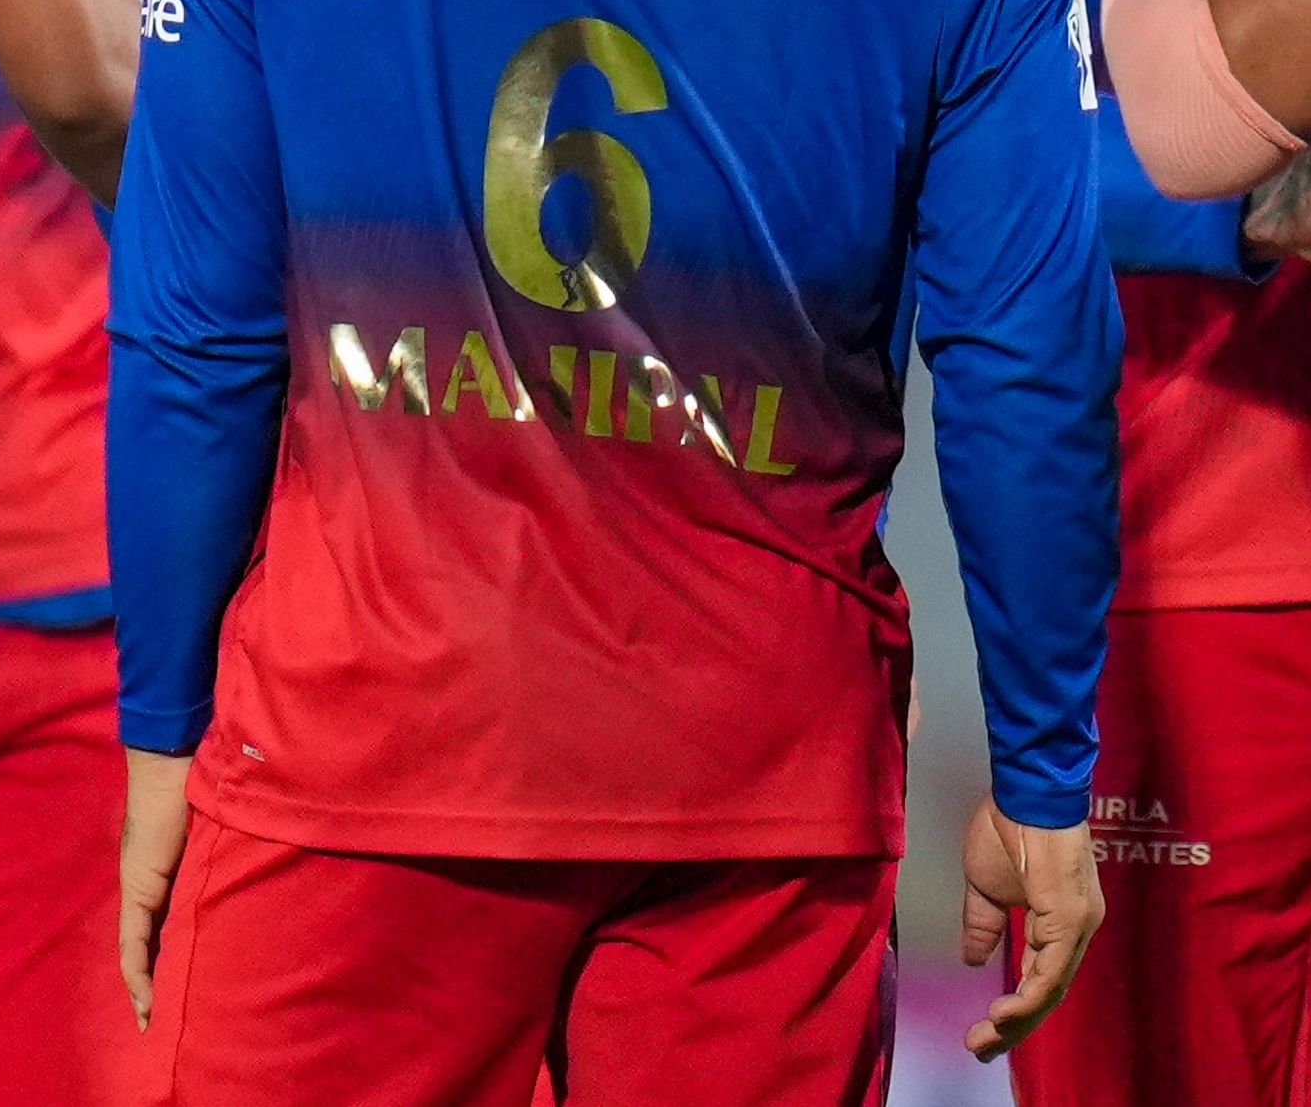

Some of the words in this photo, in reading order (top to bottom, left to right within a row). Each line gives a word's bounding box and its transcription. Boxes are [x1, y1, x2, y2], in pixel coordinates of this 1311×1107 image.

[483, 17, 669, 313] 6
[1090, 796, 1169, 824] IRLA
[1092, 839, 1212, 867] STATES
